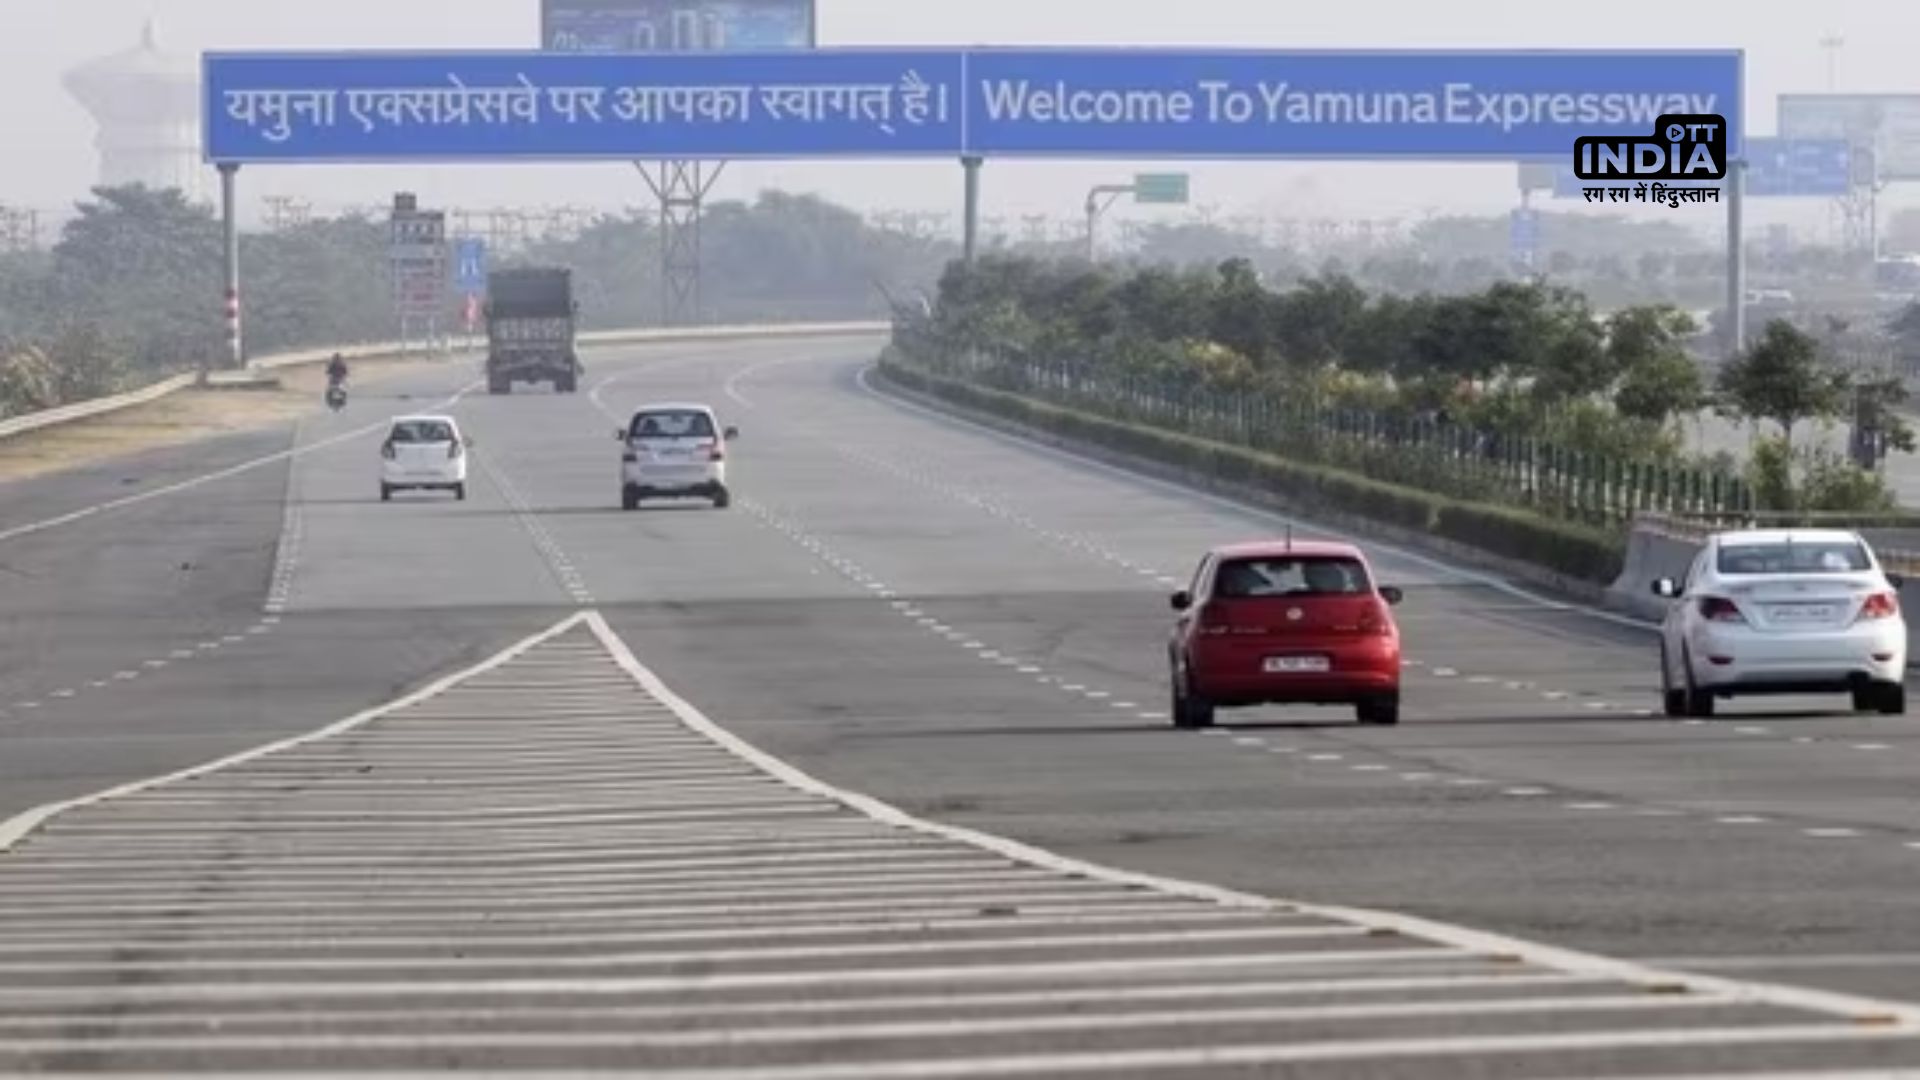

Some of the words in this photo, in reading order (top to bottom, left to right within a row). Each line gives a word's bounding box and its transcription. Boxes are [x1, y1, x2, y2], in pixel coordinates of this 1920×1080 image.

[223, 88, 337, 141] यमुना
[345, 72, 541, 133] एक्सप्रेसवे
[547, 85, 604, 123] पर
[611, 84, 752, 123] आपका
[759, 83, 895, 135] स्वागत्
[981, 79, 1194, 123] Welcome
[1199, 81, 1253, 123] To
[1258, 82, 1437, 123] Yamuna
